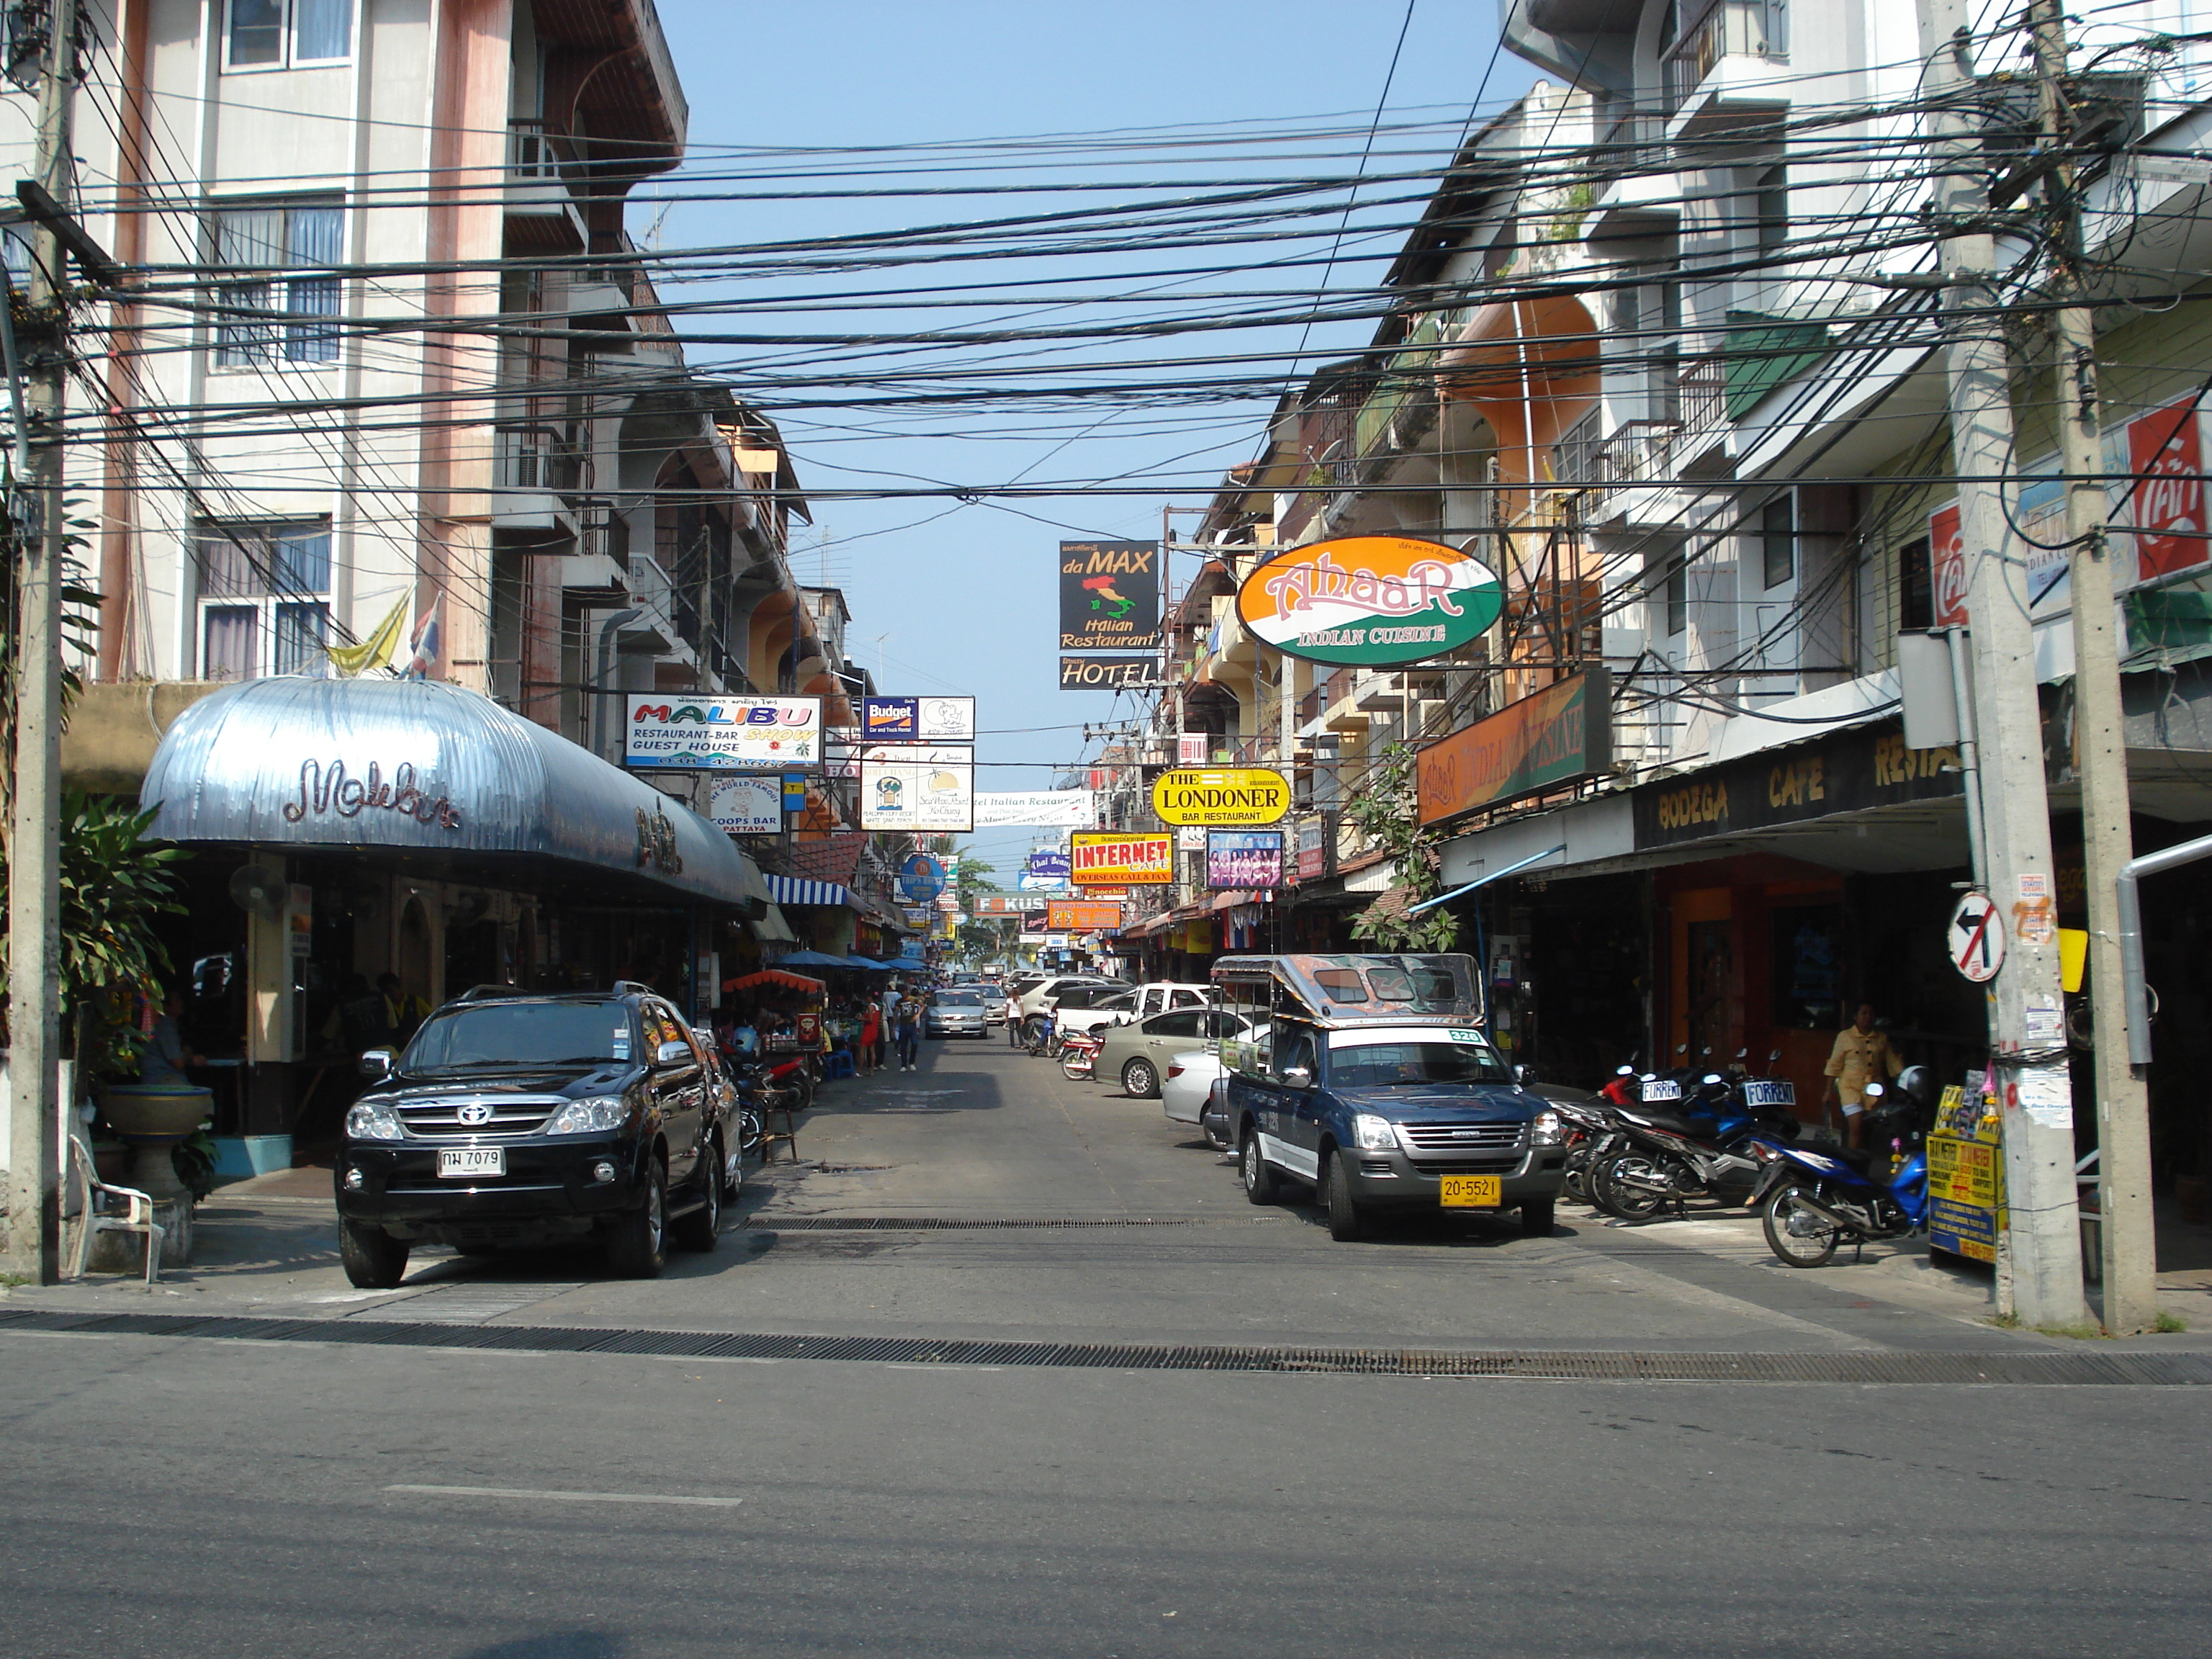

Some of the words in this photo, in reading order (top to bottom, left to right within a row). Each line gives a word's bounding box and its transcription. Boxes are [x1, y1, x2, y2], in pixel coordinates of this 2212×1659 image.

[1062, 559, 1084, 574] da
[1086, 550, 1153, 574] MAX
[1084, 619, 1134, 632] Italian
[1061, 631, 1157, 647] Restaurant
[1296, 629, 1367, 647] INDIAN
[1368, 624, 1446, 644] CUISINE
[1062, 663, 1157, 684] HOTEL
[633, 703, 812, 727] MALIBU
[869, 704, 914, 720] Budget
[634, 729, 738, 740] RESTAURANT-BAR
[743, 728, 818, 742] SHOW
[633, 741, 682, 750] GUEST
[688, 742, 740, 752] HOUSE
[658, 757, 789, 768] 038-428667
[1167, 773, 1200, 785] THE
[720, 781, 750, 792] WORLD
[752, 781, 779, 804] FAMOUS
[1163, 789, 1280, 808] LONDONER
[1659, 779, 1729, 830] BODEGA
[1768, 756, 1825, 809] CAFE
[990, 797, 1025, 806] Italian
[1182, 812, 1200, 821] BAR
[1204, 811, 1262, 821] RESTAURANT
[1075, 841, 1167, 868] INTERNET
[1030, 857, 1048, 870] Thai
[980, 897, 1045, 912] FOKUS
[1027, 916, 1048, 928] Spicy
[443, 1153, 462, 1166] กม
[465, 1151, 498, 1165] 7079
[1445, 1180, 1495, 1196] 20-5521
